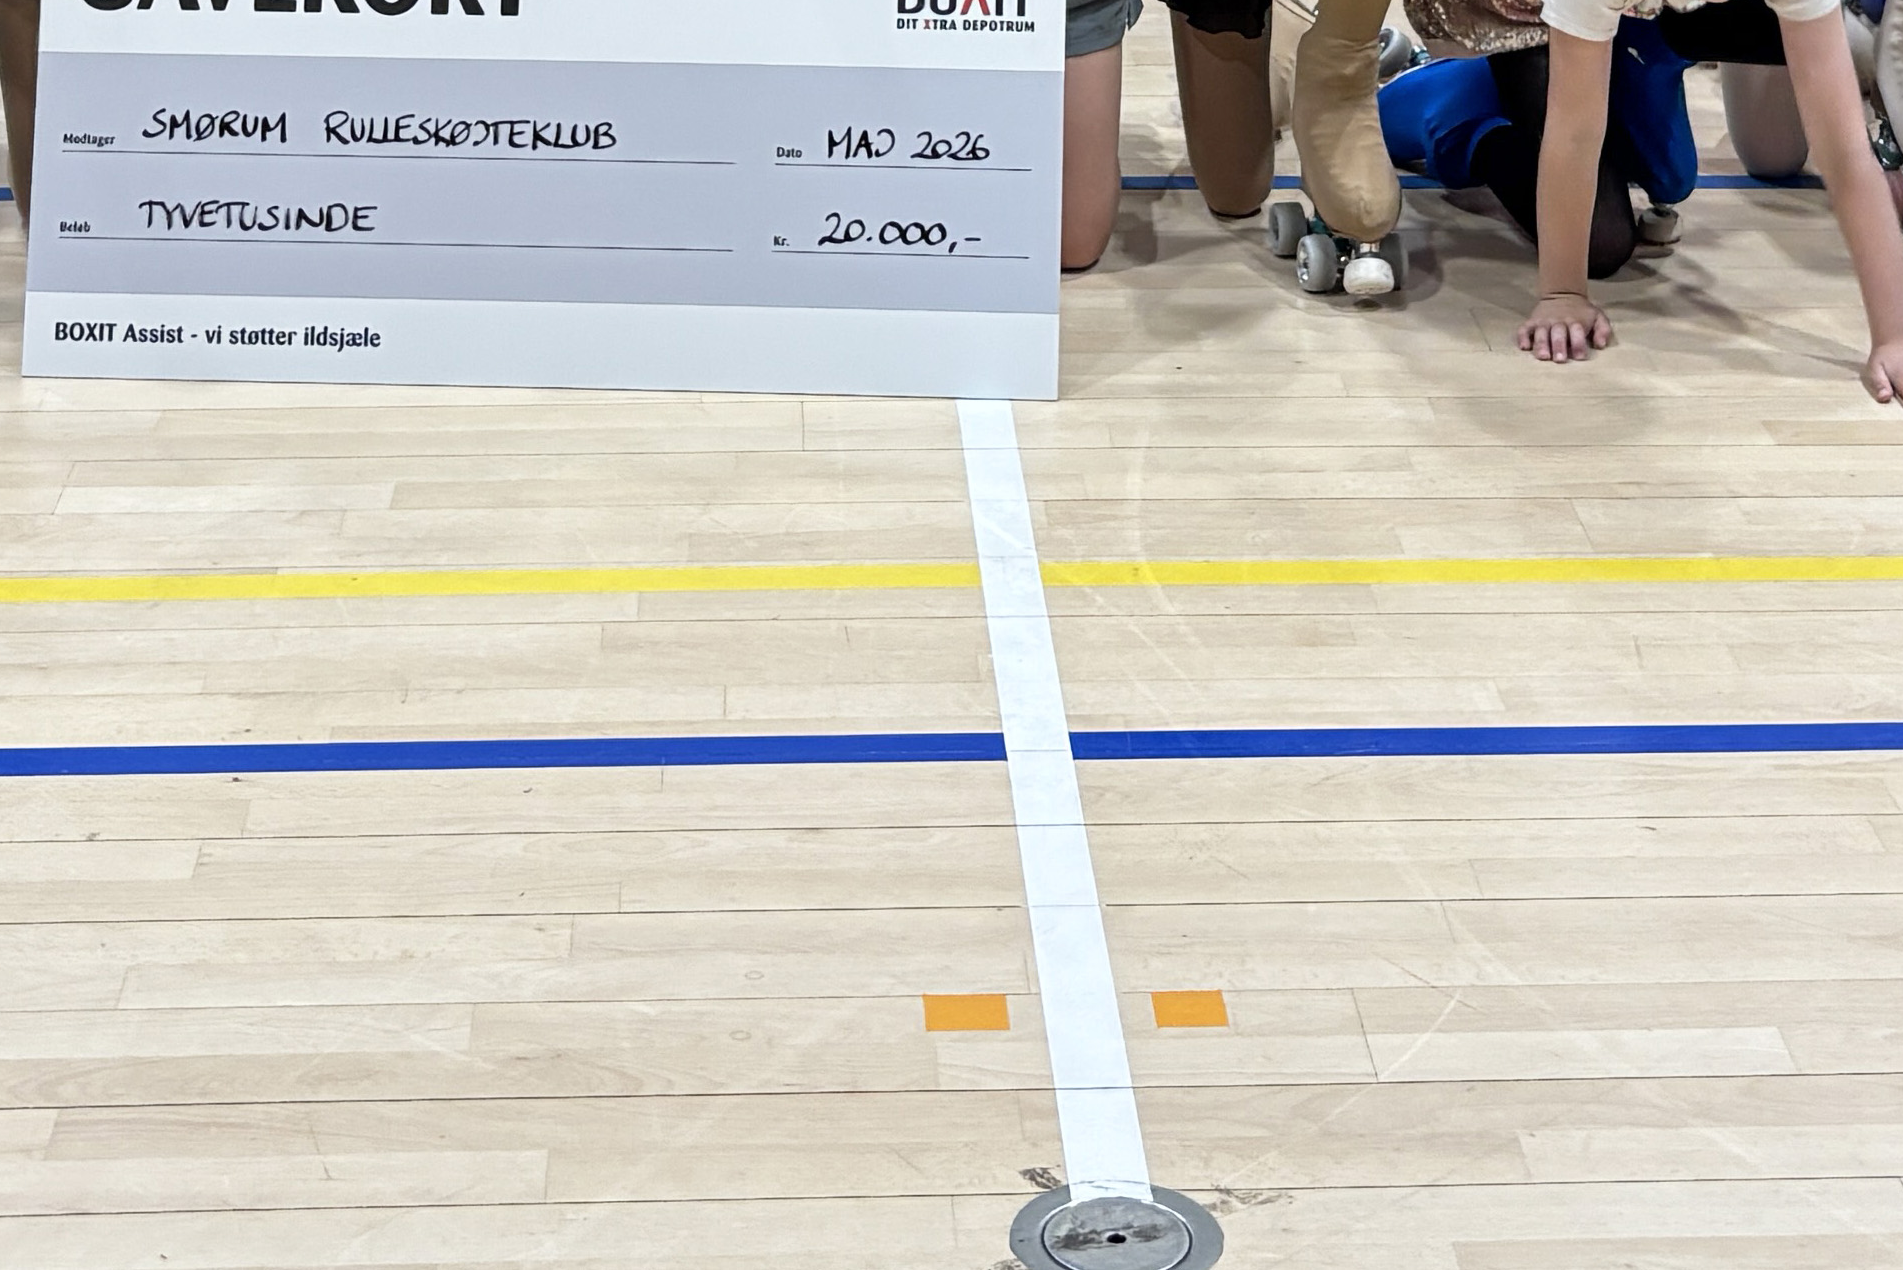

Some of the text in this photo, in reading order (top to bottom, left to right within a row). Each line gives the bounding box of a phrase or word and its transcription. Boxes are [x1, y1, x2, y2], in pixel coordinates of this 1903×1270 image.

[897, 18, 1035, 33] DIT XTRA DEPOTRUM
[63, 133, 115, 147] Modtager
[142, 108, 287, 143] SMØRUM
[776, 146, 802, 158] Dato
[828, 126, 990, 161] MAJ 2026
[138, 200, 378, 232] TYVETUSINDE
[55, 322, 117, 343] BOXIT
[122, 323, 184, 344] Assist
[205, 325, 222, 345] vi
[229, 326, 297, 347] støtter
[304, 326, 381, 352] ildsjæle
